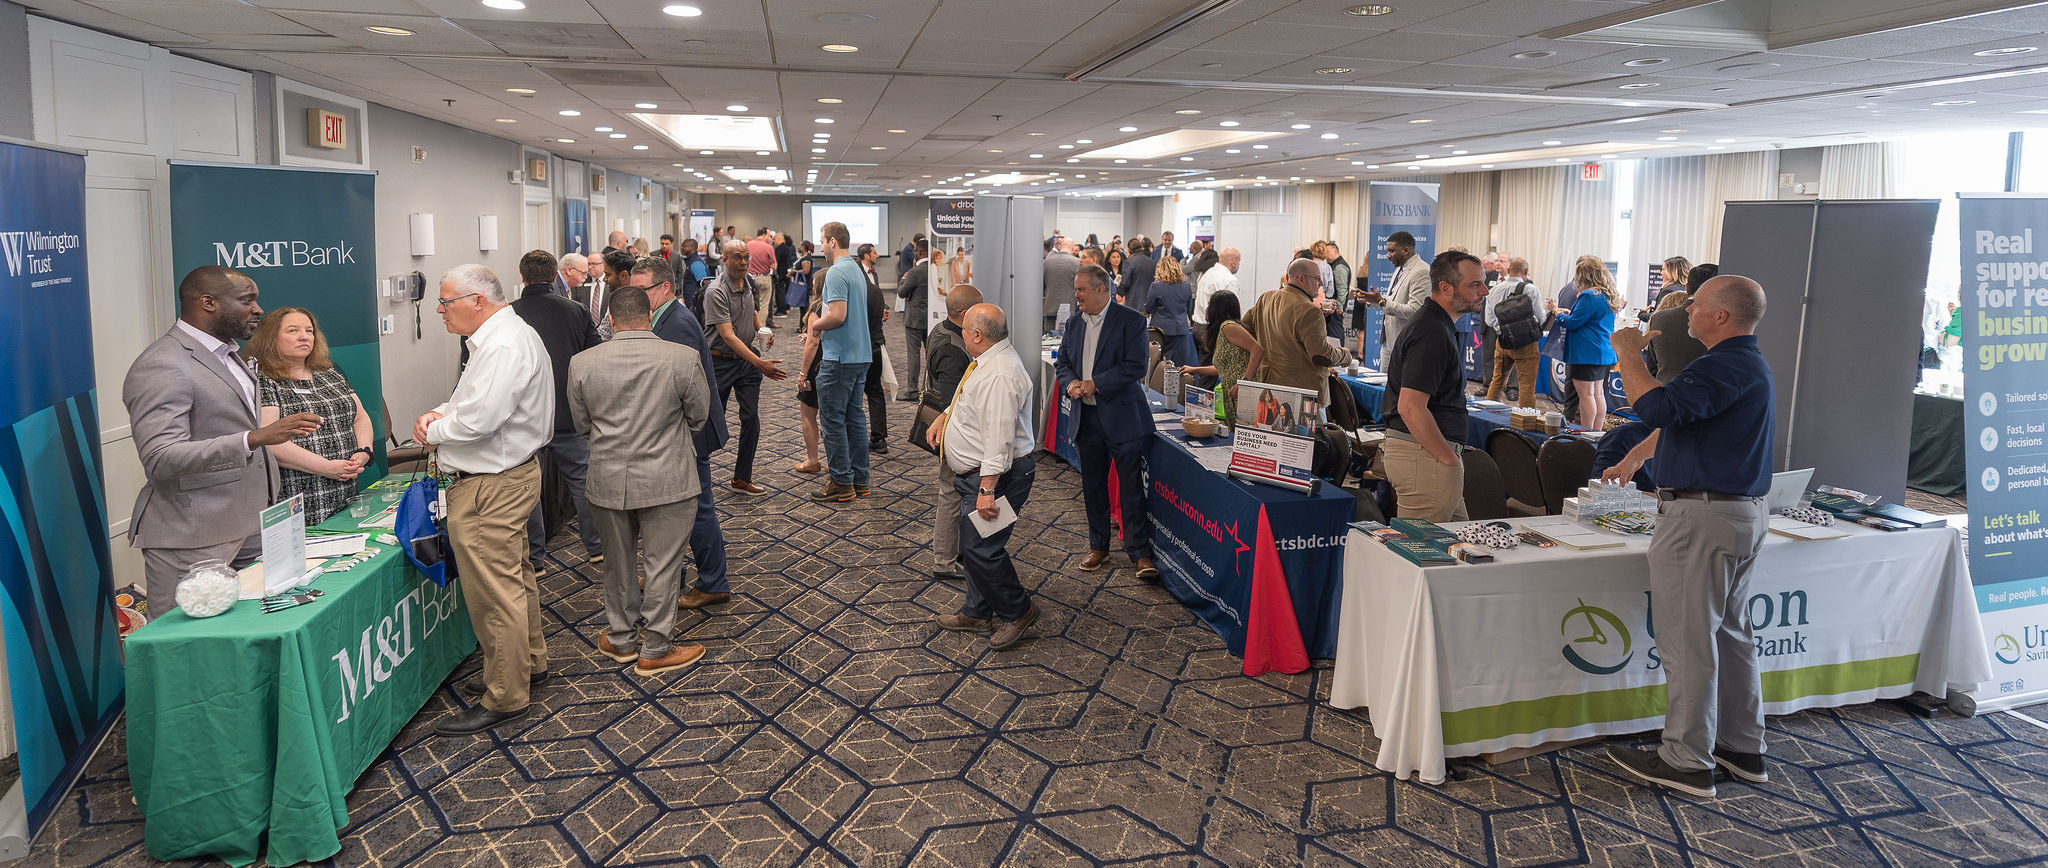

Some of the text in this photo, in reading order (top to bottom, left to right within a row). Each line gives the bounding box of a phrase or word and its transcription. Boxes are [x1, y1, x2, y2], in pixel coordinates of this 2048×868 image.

[325, 114, 343, 145] EXIT
[1584, 164, 1599, 179] EXIT
[1383, 202, 1432, 216] IVES BANK
[936, 214, 960, 222] Unlock
[25, 230, 80, 254] Wilmington
[1976, 227, 2033, 255] Real
[213, 240, 355, 269] M&T Bank
[26, 254, 52, 275] Trust
[1976, 281, 2017, 308] for
[2005, 391, 2037, 403] Tailored
[1237, 430, 1267, 441] DOES YOUR
[2006, 422, 2045, 435] Fast, local
[1236, 435, 1278, 448] BUSINESS NEED
[1236, 440, 1261, 449] CAPITAL?
[2006, 437, 2043, 448] decisions
[2007, 476, 2042, 492] personal
[1154, 479, 1223, 544] ctsbdc.uconn.edu
[1984, 509, 2041, 530] Let's talk
[1984, 531, 2016, 545] about
[1201, 561, 1215, 578] costo
[1989, 591, 2007, 604] Real
[2009, 587, 2039, 603] people.
[331, 588, 420, 724] M&T
[2000, 686, 2014, 694] FDIC
